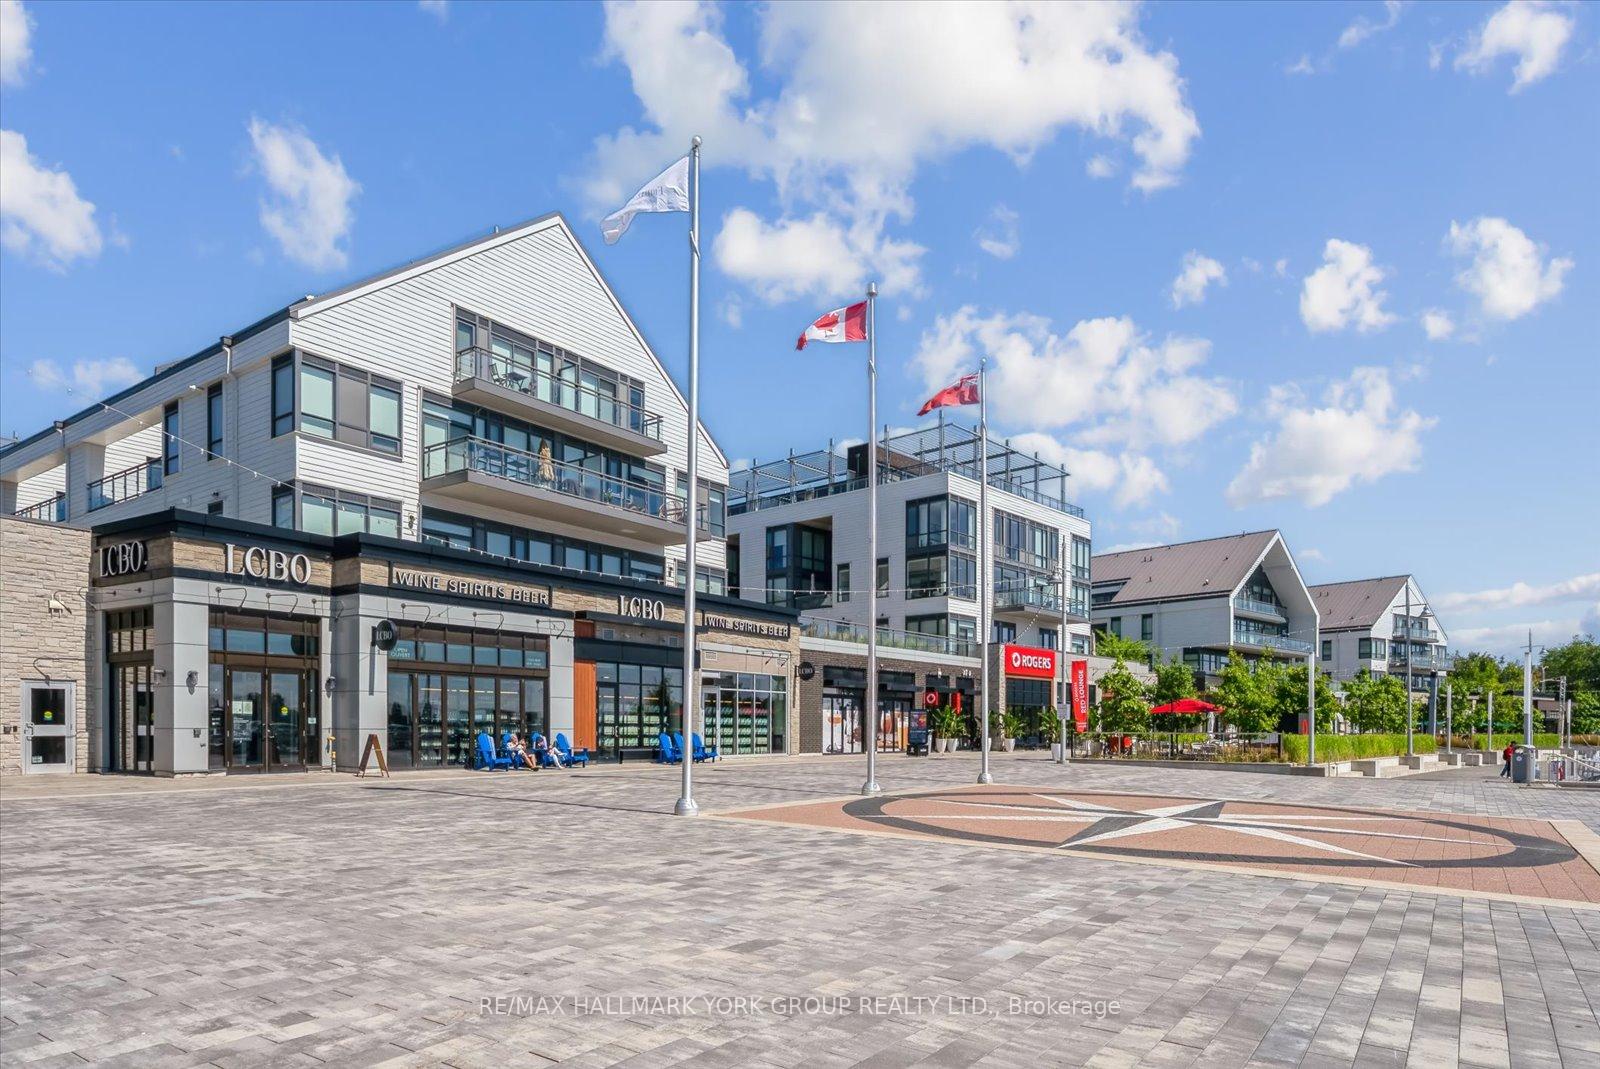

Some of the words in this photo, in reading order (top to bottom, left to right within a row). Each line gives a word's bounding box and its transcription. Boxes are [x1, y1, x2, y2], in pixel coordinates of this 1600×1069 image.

[100, 541, 143, 577] LCBO
[226, 543, 311, 584] LCBO
[398, 571, 441, 590] WINE
[448, 579, 506, 599] SPIRITS
[513, 589, 549, 605] BEER
[620, 595, 664, 621] LCBO
[376, 630, 393, 641] LCBO
[734, 620, 767, 635] SPIRITS
[768, 626, 788, 637] BEER
[1022, 655, 1051, 669] ROGERS
